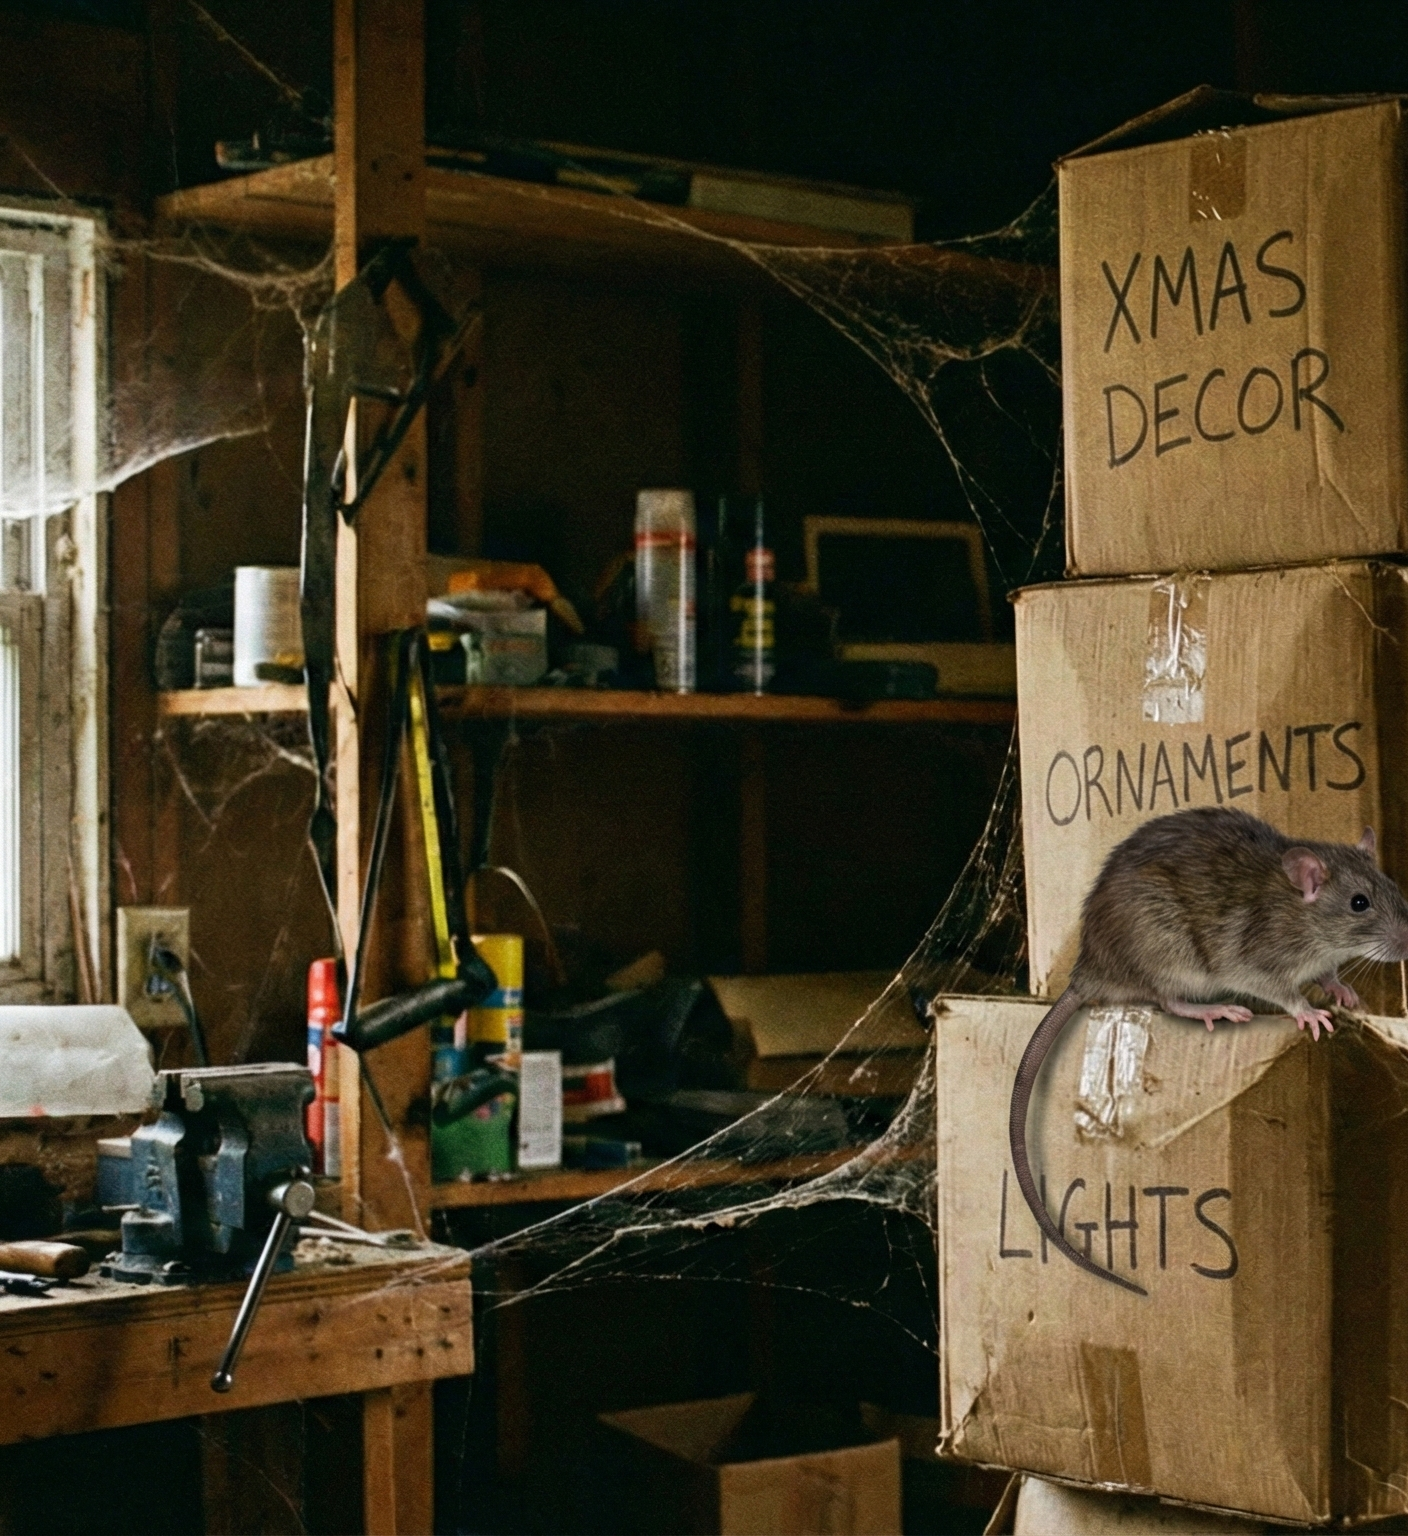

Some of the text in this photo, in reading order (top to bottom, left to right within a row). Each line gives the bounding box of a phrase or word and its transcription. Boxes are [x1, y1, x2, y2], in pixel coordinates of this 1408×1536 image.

[1101, 229, 1307, 355] XMAS
[1102, 347, 1346, 470] DECOR
[1046, 721, 1367, 827] ORNAMENTS
[999, 1168, 1239, 1281] LIGHTS
